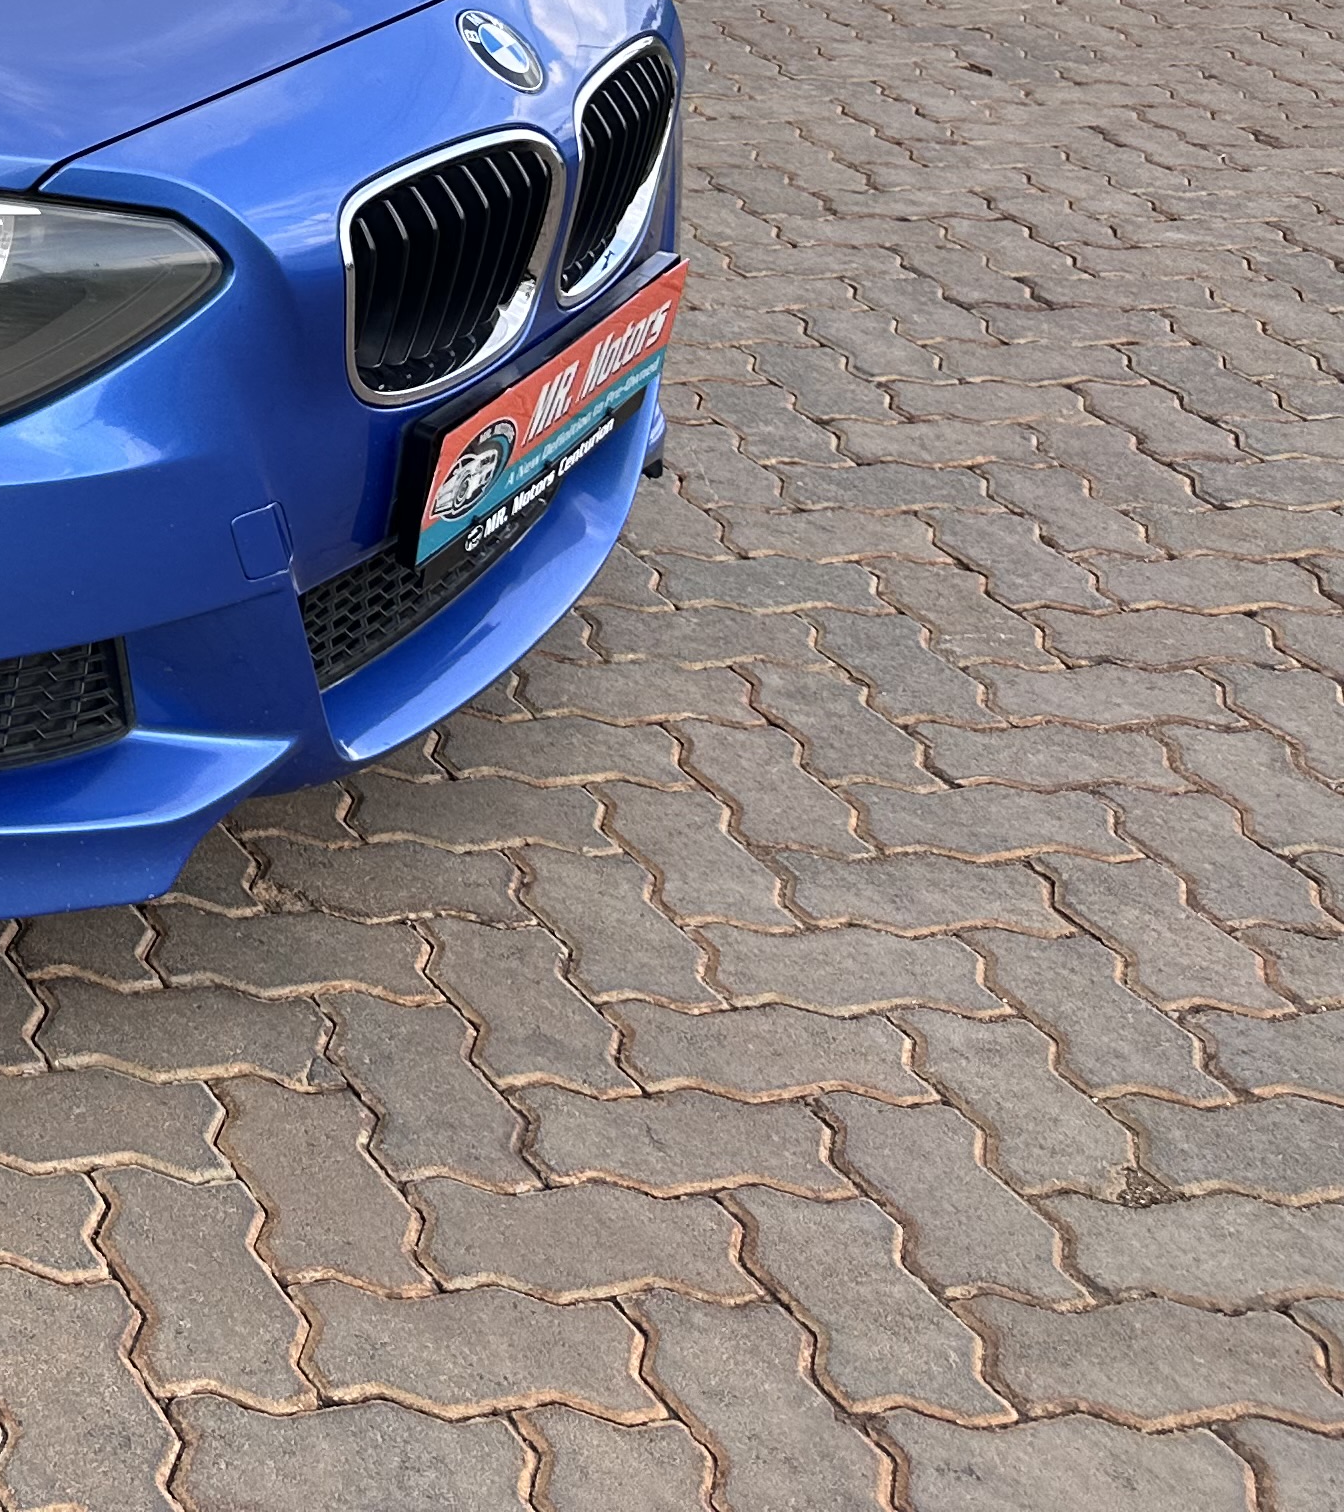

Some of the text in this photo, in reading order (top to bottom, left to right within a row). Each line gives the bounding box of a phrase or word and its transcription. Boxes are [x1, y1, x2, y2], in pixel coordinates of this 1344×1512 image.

[505, 473, 516, 489] A
[516, 454, 541, 479] New
[542, 411, 592, 459] Definition
[593, 402, 604, 417] to
[604, 355, 661, 407] Pre-Owned
[521, 299, 673, 448] MR. Motors
[484, 506, 508, 538] MR.
[511, 470, 556, 516] Motors
[558, 417, 616, 477] Centurion
